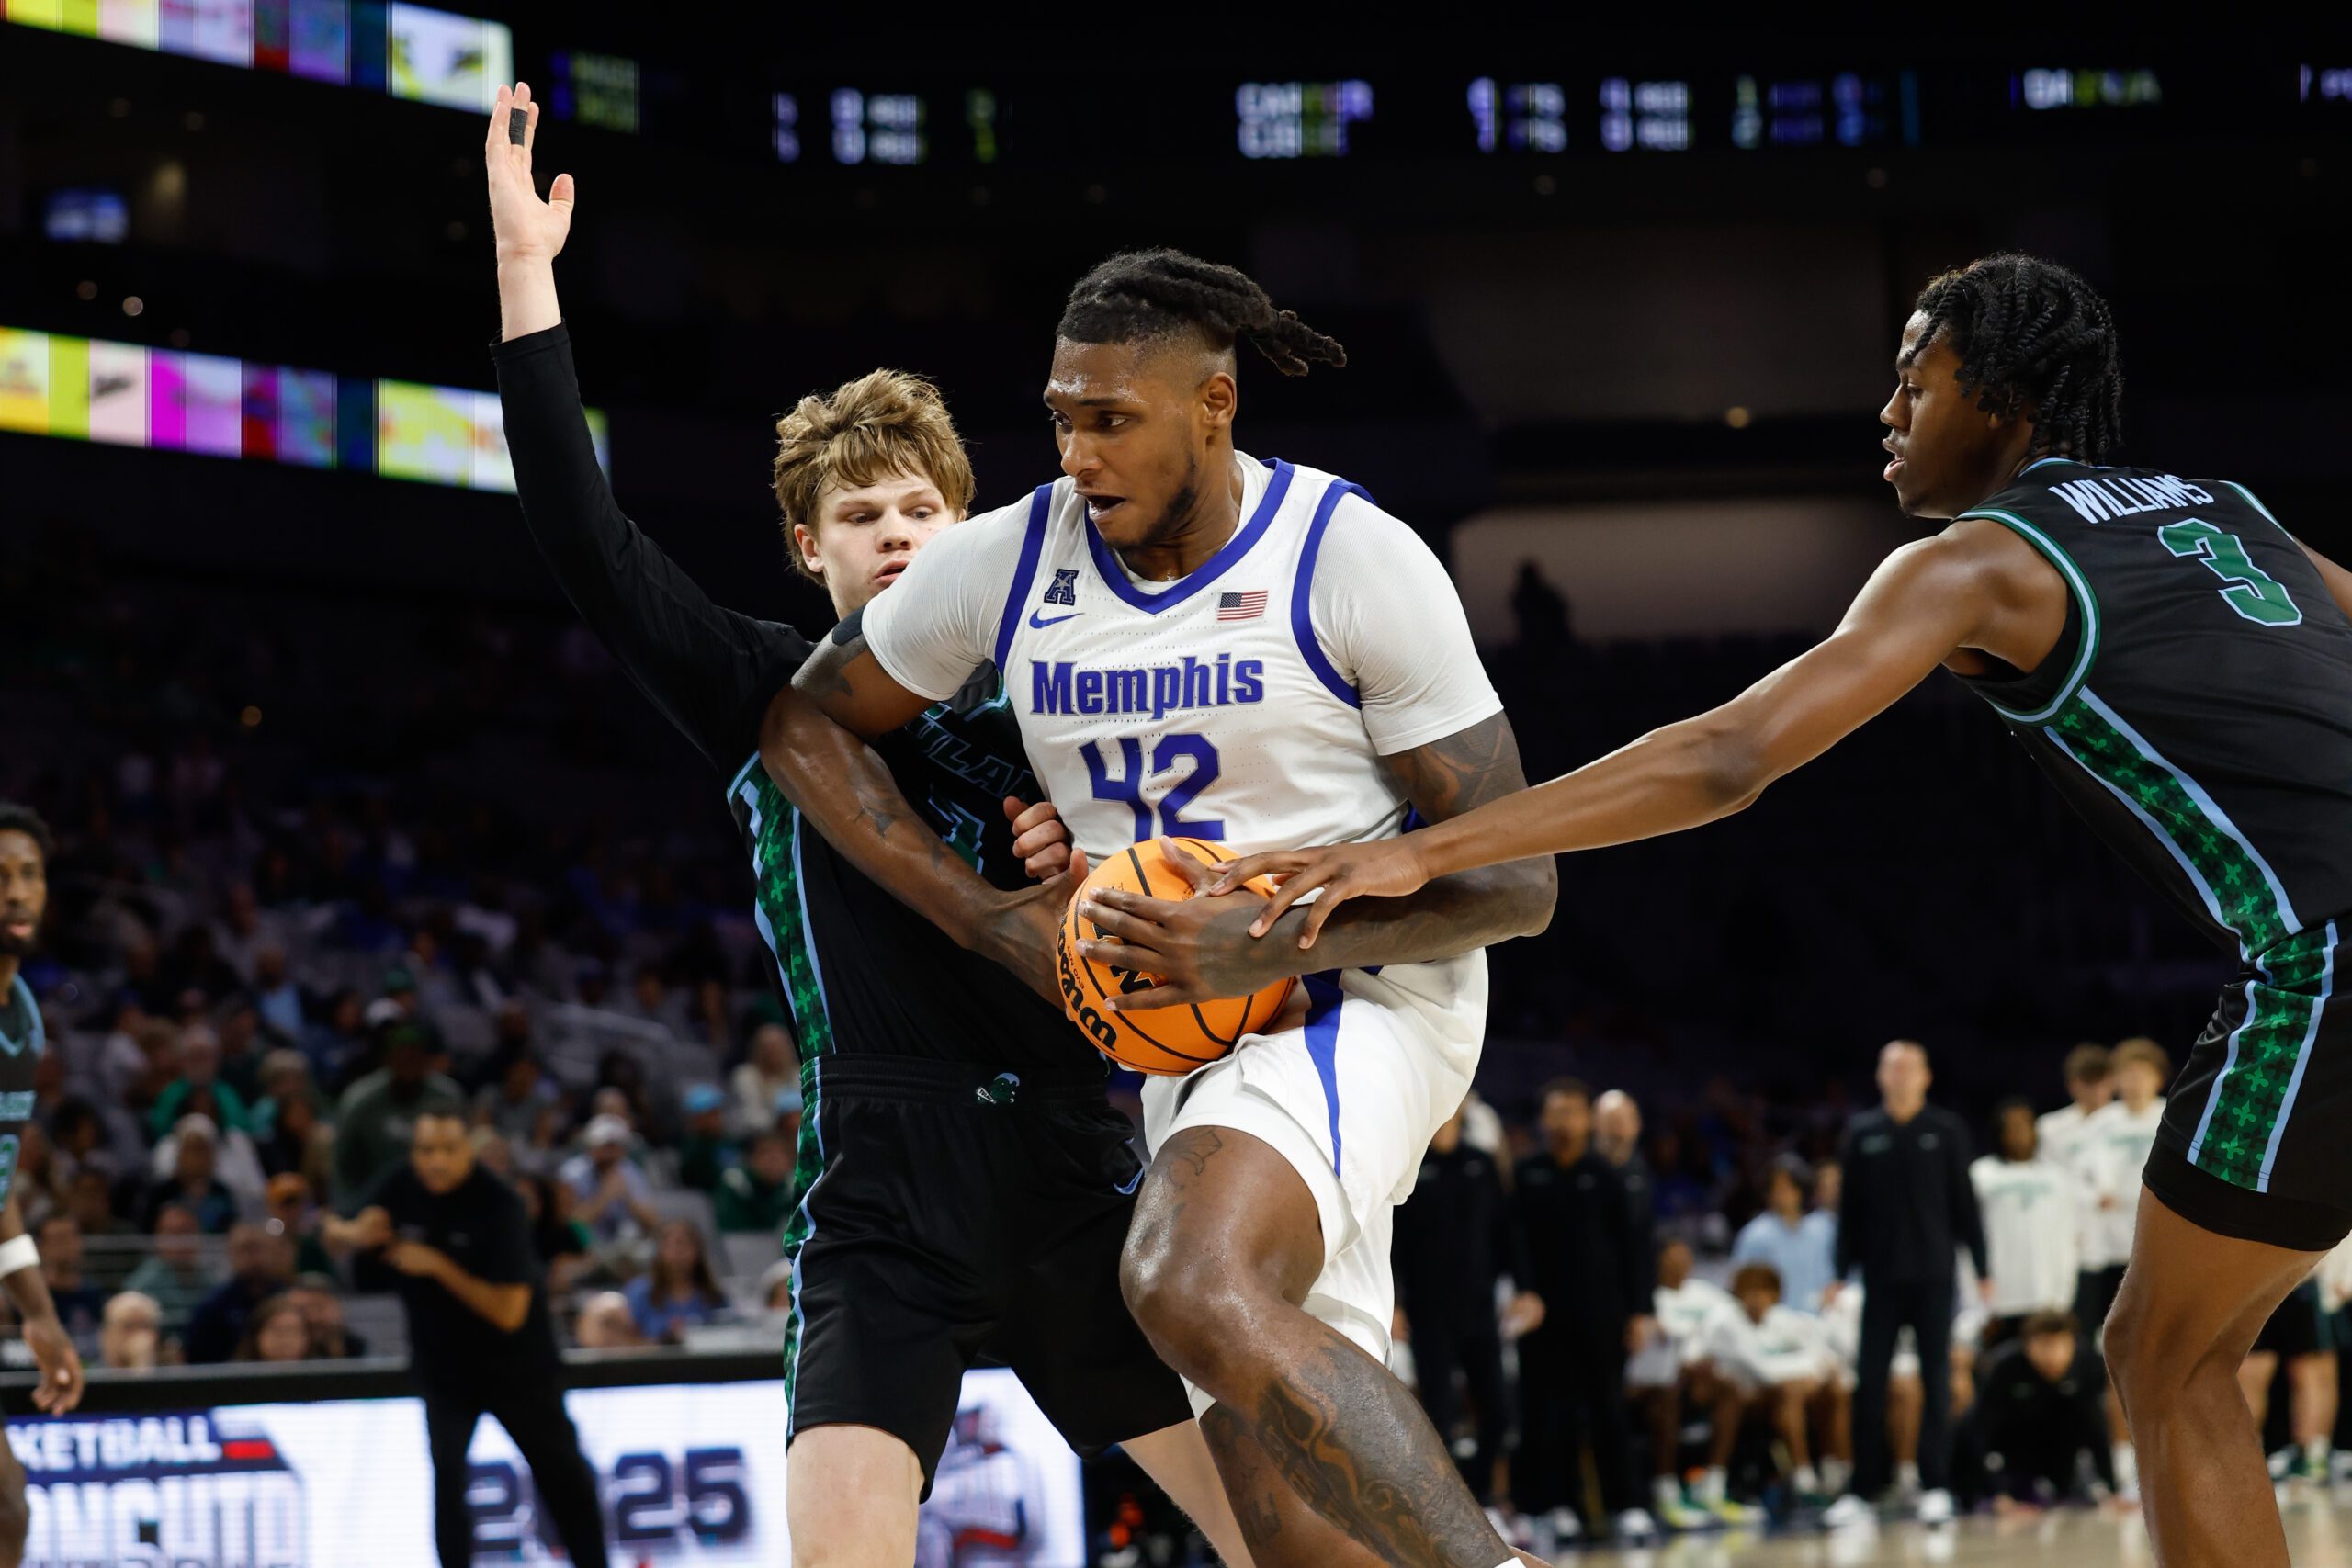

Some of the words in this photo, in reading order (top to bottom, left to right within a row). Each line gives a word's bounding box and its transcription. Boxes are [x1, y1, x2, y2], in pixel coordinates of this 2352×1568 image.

[2048, 474, 2214, 524] WILLIAMS
[1044, 569, 1080, 606] A
[2156, 517, 2303, 626] 3
[1029, 652, 1264, 722] Memphis
[1078, 732, 1227, 843] 42
[463, 1445, 752, 1554] 225
